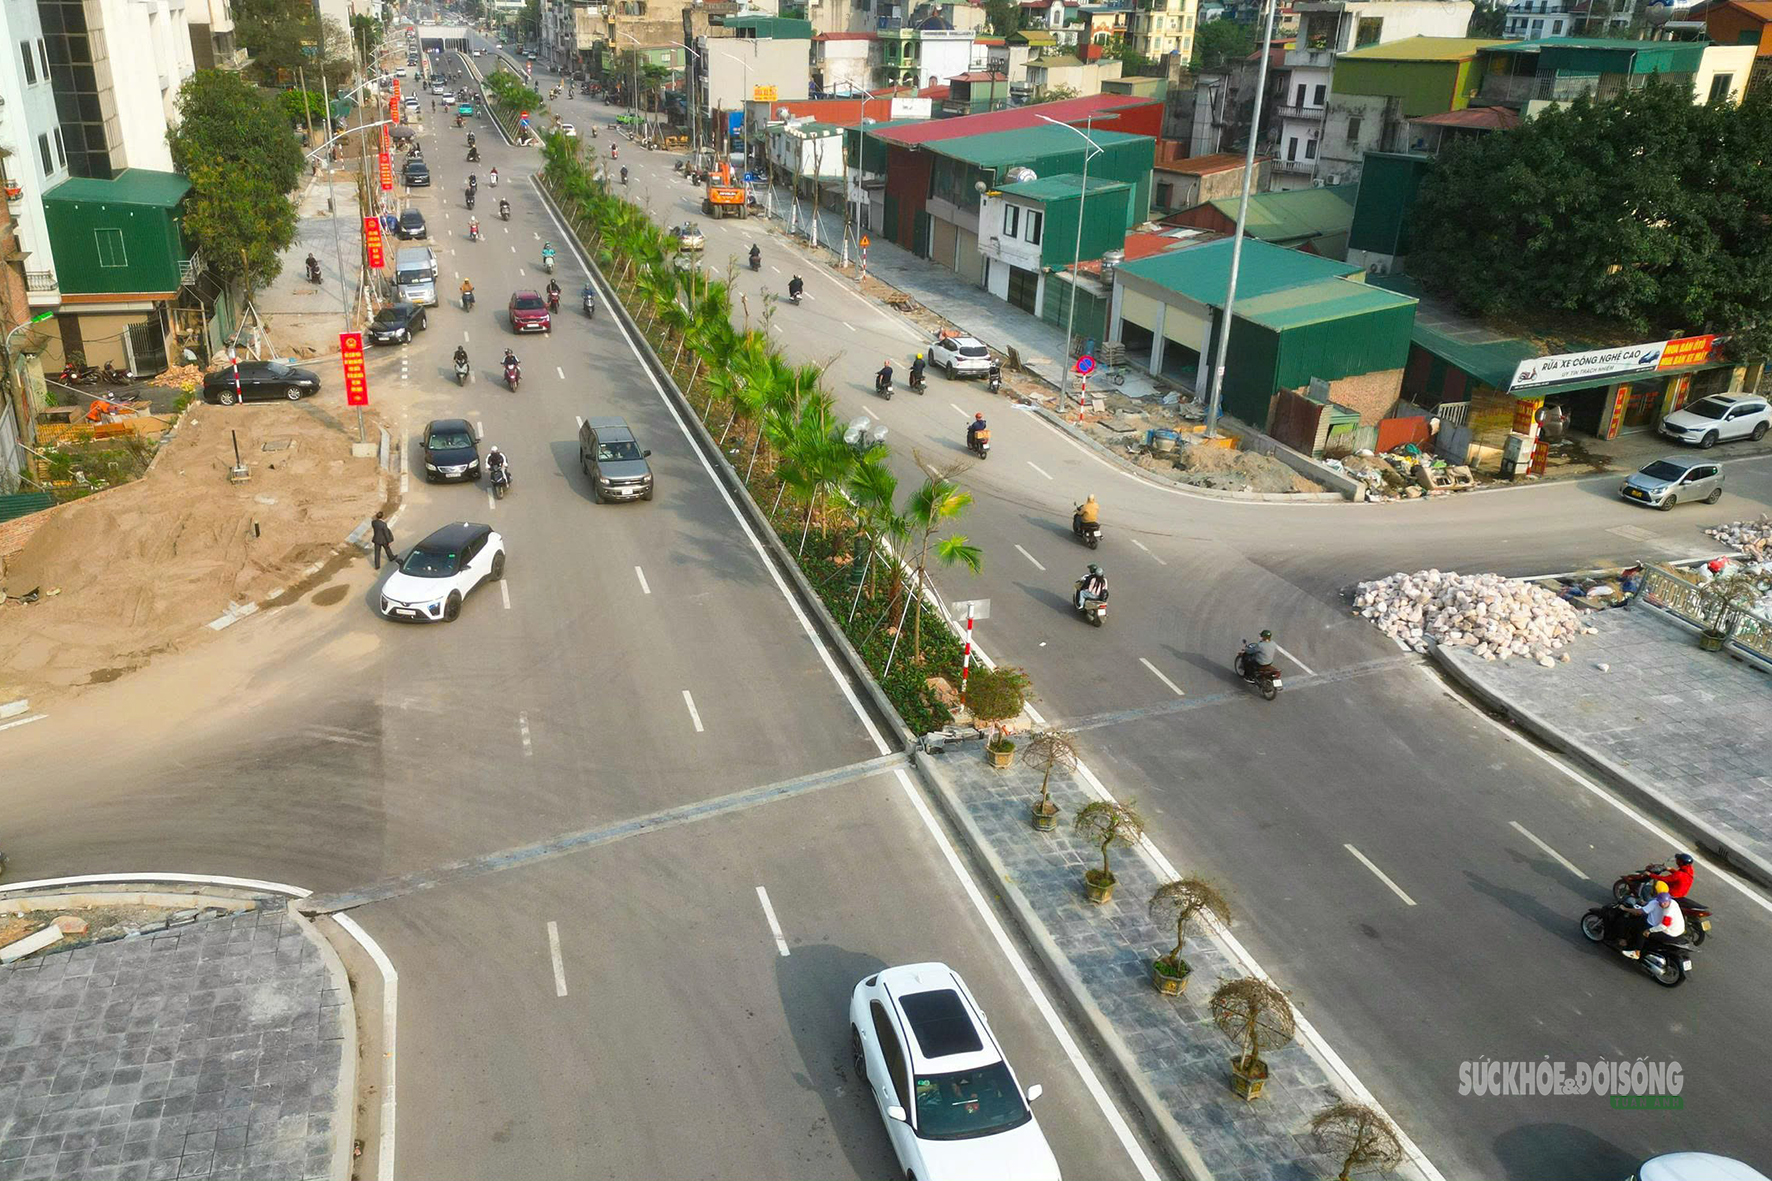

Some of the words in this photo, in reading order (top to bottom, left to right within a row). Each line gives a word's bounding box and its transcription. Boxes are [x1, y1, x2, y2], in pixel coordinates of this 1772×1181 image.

[1541, 359, 1558, 371] RỬA
[1561, 360, 1571, 369] XE
[1572, 354, 1599, 367] CÔNG
[1599, 351, 1622, 364] NGHỆ
[1622, 350, 1641, 360] CAO
[1561, 370, 1570, 378] UY
